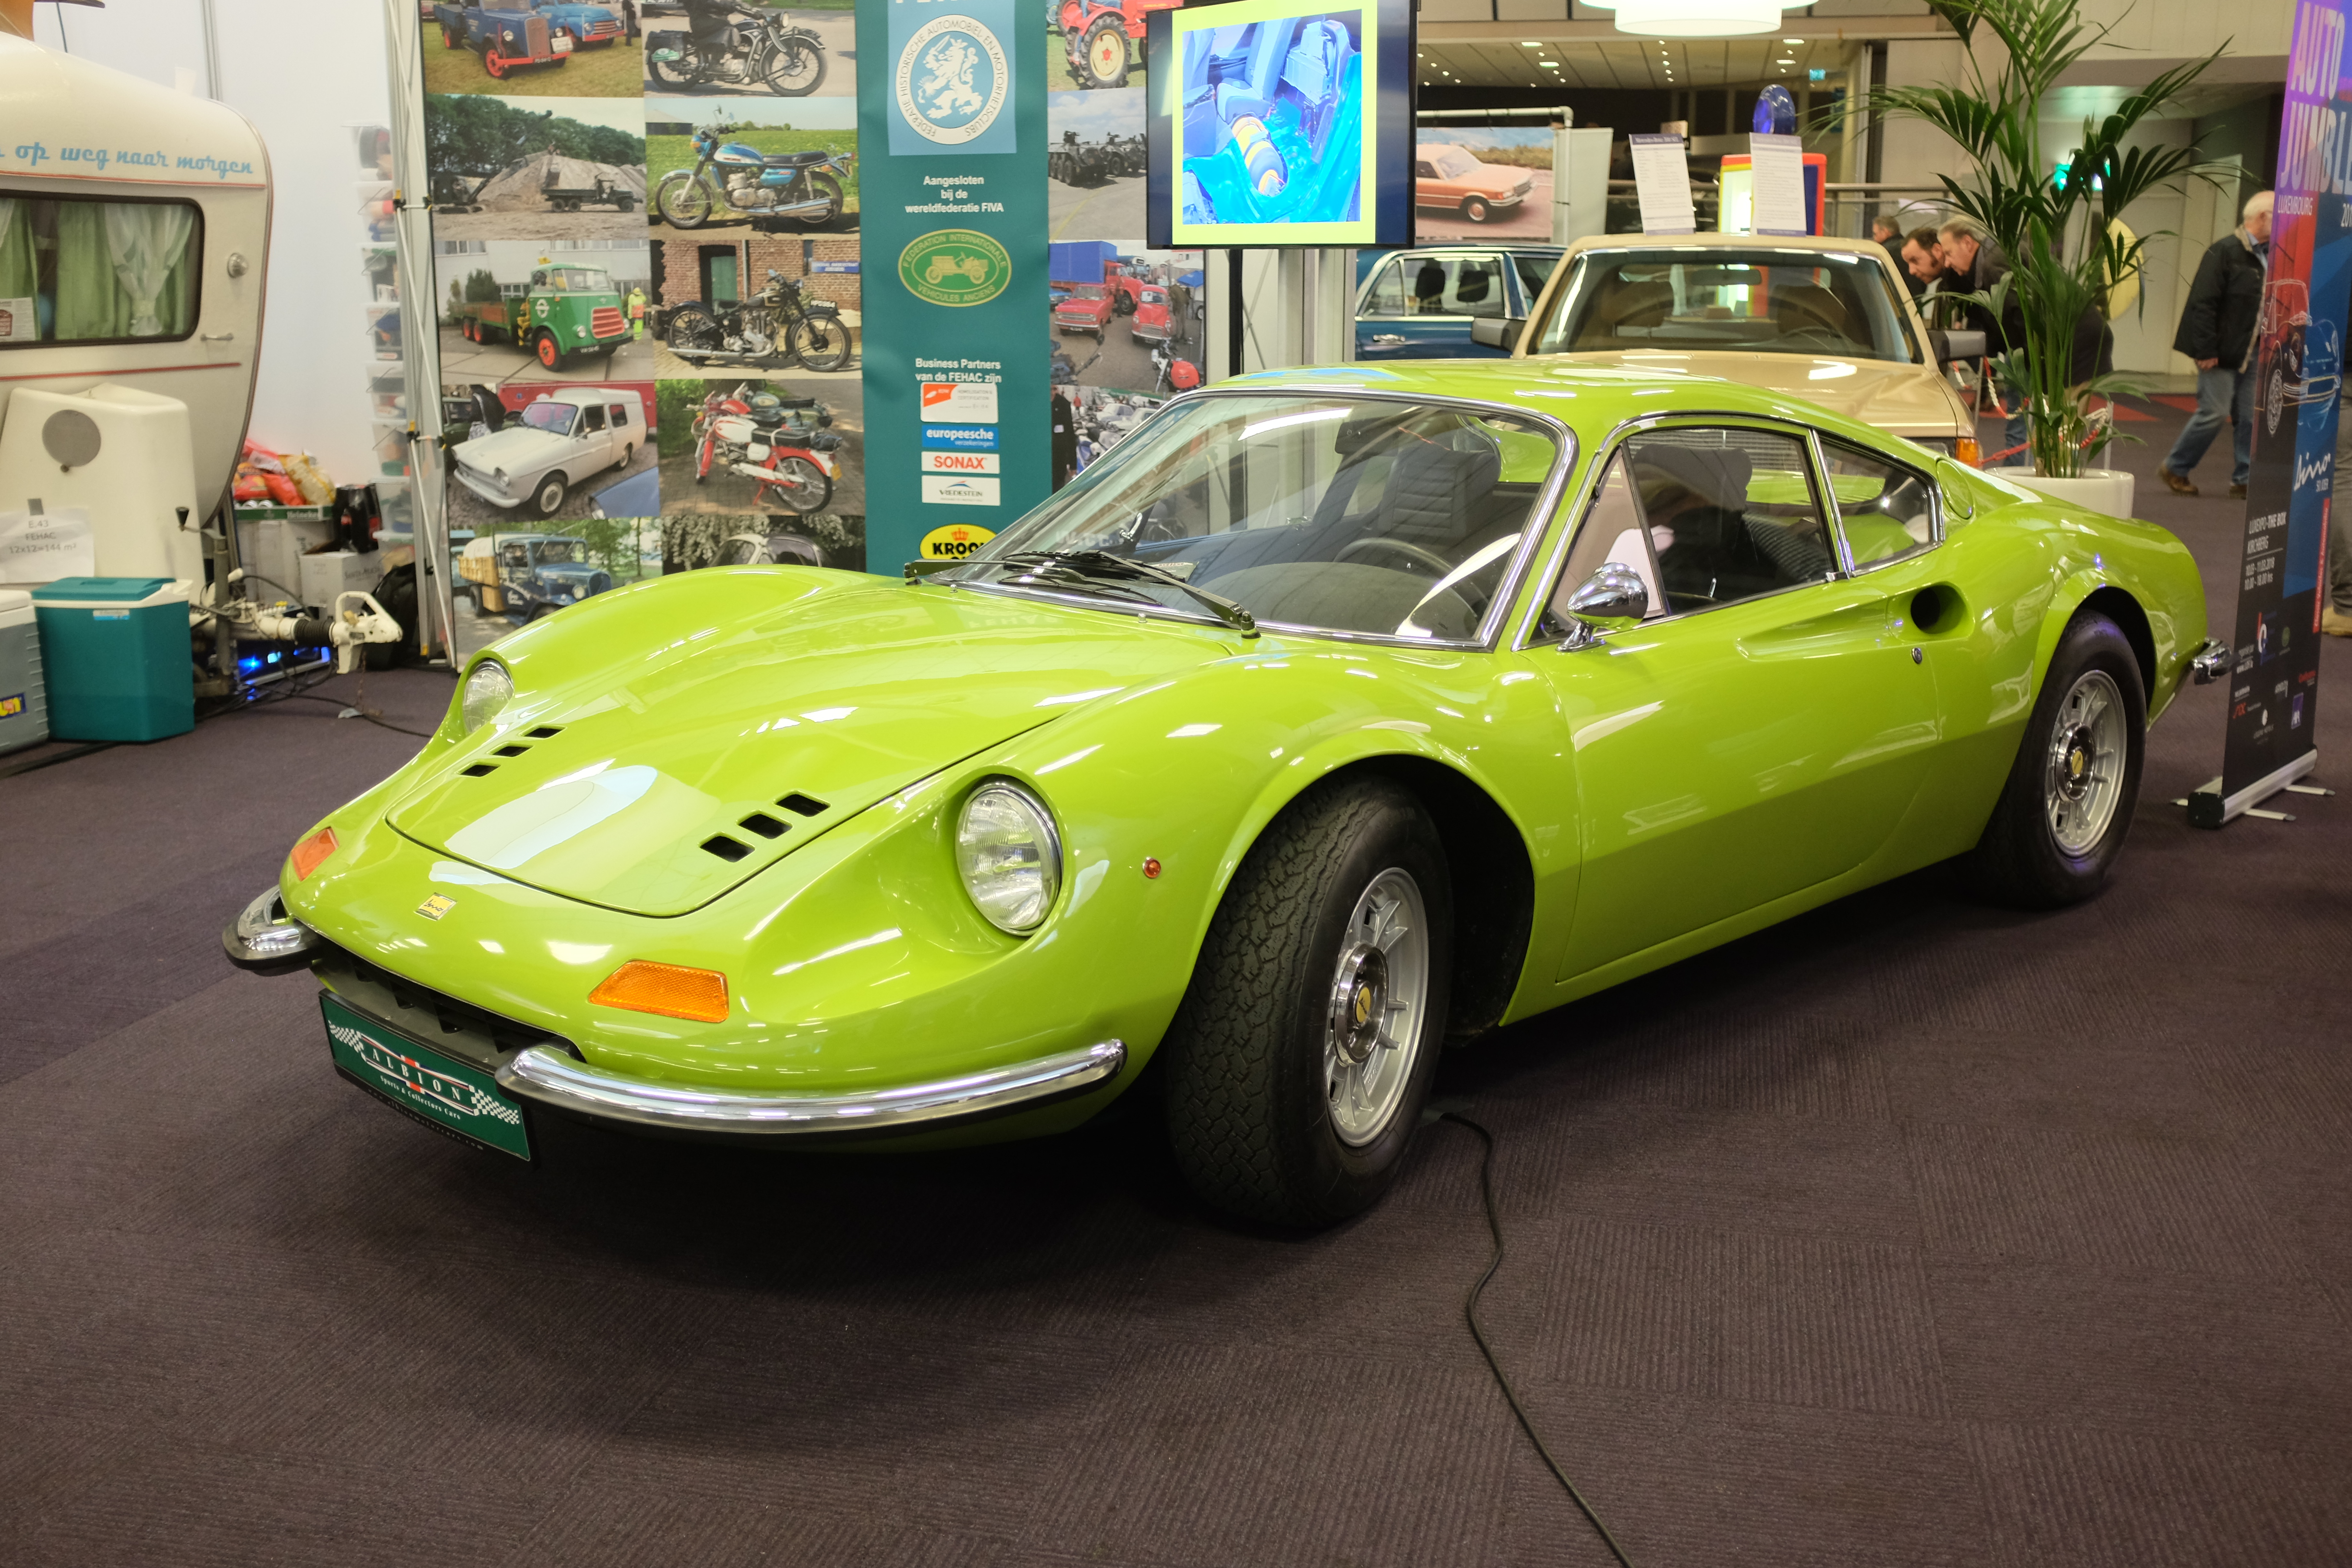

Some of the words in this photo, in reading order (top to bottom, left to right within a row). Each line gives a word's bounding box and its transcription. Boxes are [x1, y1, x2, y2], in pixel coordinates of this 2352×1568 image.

[2291, 1, 2345, 100] AUTO
[899, 34, 926, 97] HISTORISCHE
[983, 36, 995, 50] EN
[15, 142, 50, 166] op
[61, 147, 110, 171] weg
[176, 156, 253, 179] morgen
[923, 175, 984, 187] Aangesloten
[941, 189, 954, 201] bij
[955, 189, 968, 198] de
[905, 203, 980, 213] wereldfederatie
[981, 202, 1004, 212] FIVA
[2278, 195, 2313, 216] LUXEMBOURG
[902, 234, 947, 268] FEDERATION
[949, 234, 1007, 268] INTERNATIONALE
[918, 284, 960, 302] VEHICULES
[963, 285, 996, 302] ANCIENS
[915, 358, 959, 368] Business
[961, 359, 1002, 369] Partners
[934, 372, 947, 381] de
[948, 372, 983, 382] FEHAC
[984, 373, 1002, 385] zijn
[926, 429, 994, 441] europeesche
[934, 456, 985, 469] SONAX
[25, 532, 56, 540] FEHAC
[373, 1049, 461, 1101] ALBION
[380, 1075, 400, 1090] Sports
[407, 1090, 442, 1112] Collectors
[444, 1108, 461, 1120] Cars
